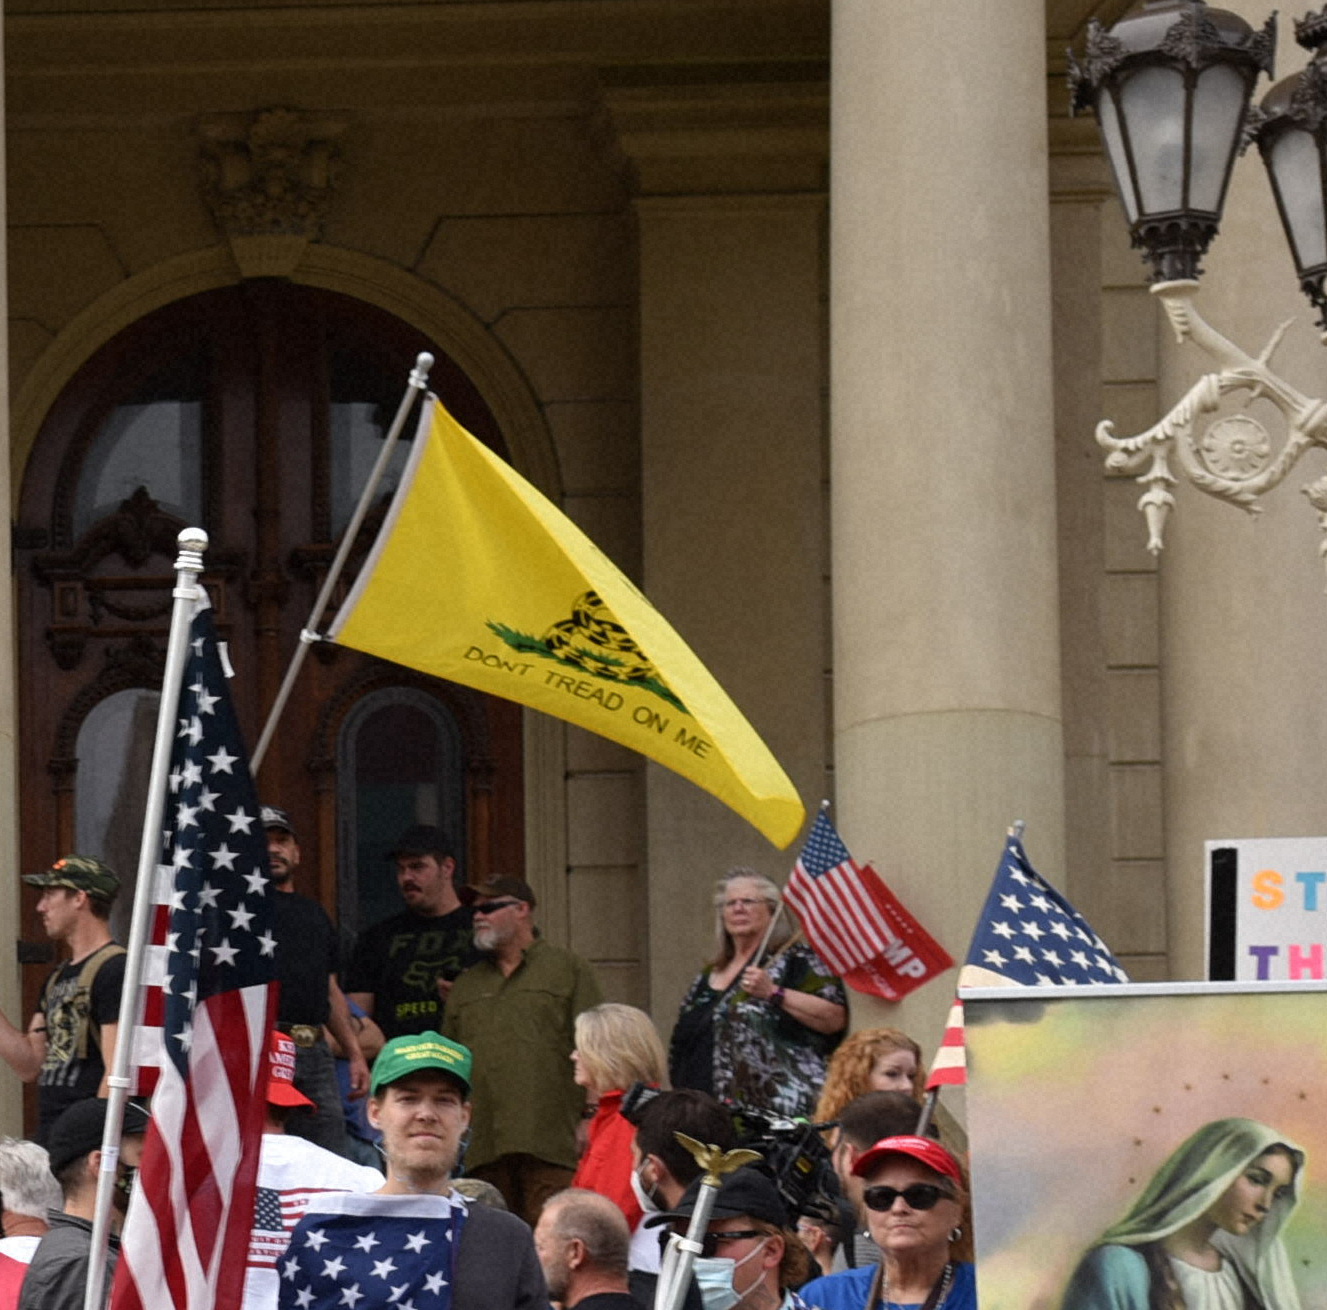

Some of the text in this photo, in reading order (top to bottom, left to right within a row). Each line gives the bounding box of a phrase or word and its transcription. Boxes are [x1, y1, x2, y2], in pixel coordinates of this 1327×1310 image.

[543, 669, 624, 712] TREAD
[632, 706, 670, 734] ON
[674, 728, 713, 760] ME
[396, 1000, 438, 1020] SPEED
